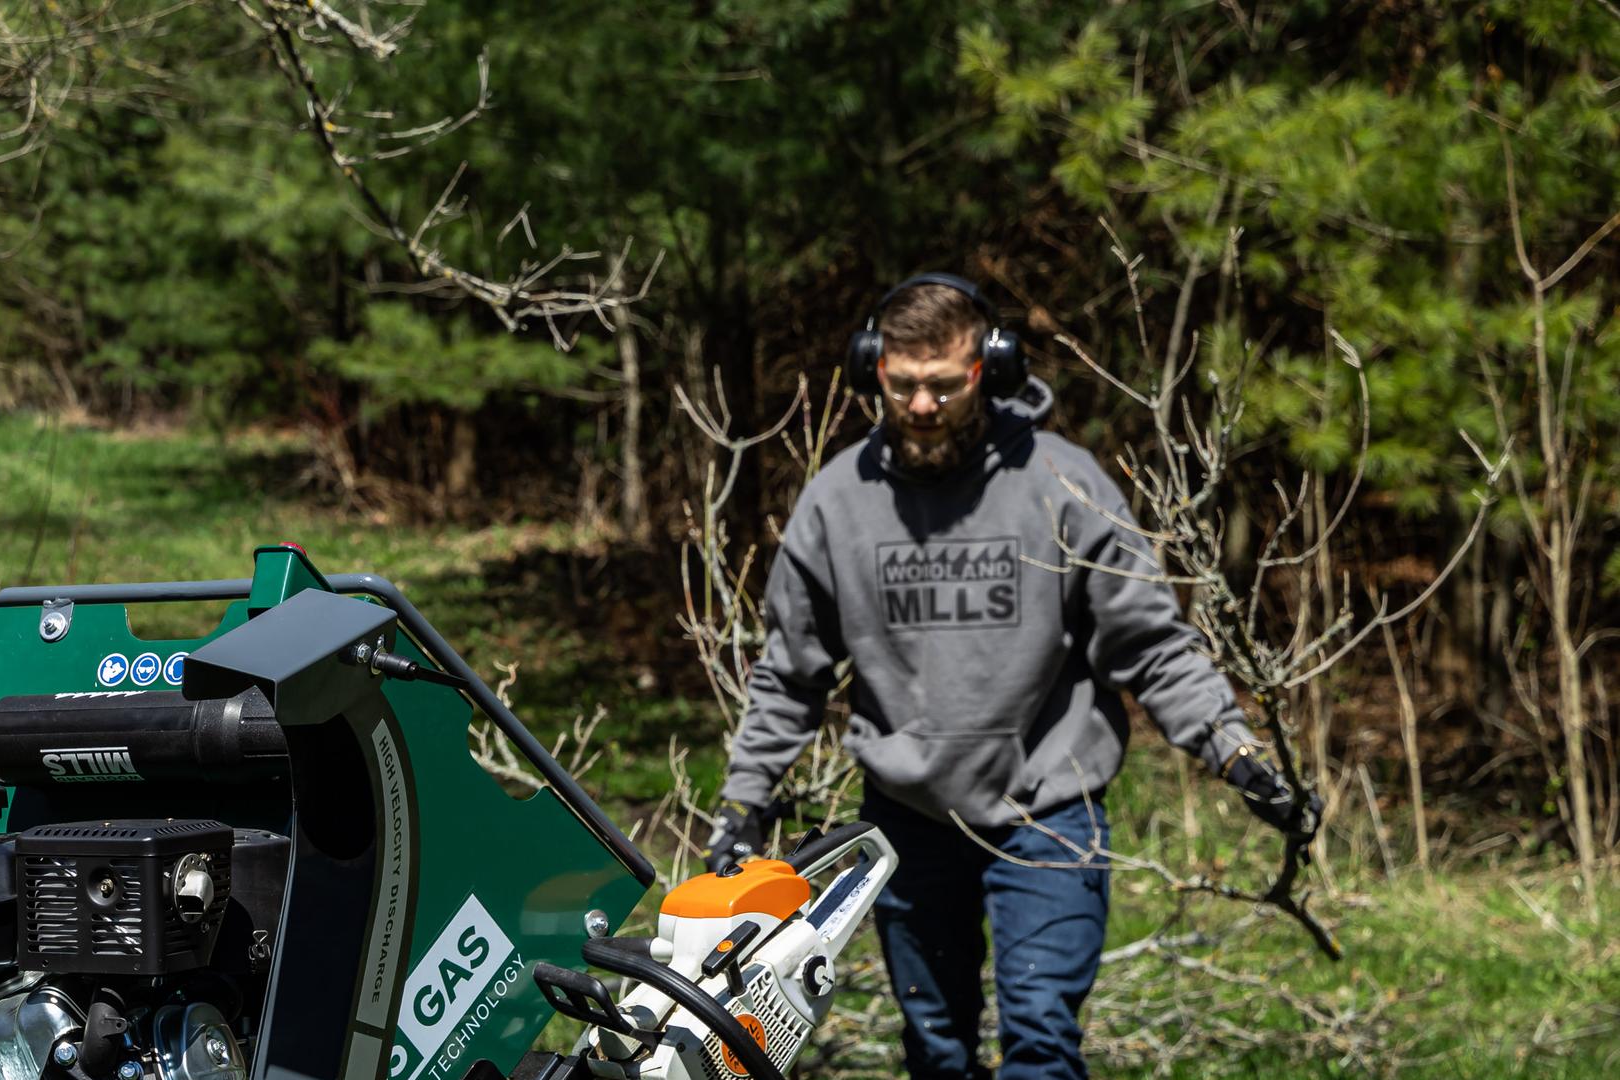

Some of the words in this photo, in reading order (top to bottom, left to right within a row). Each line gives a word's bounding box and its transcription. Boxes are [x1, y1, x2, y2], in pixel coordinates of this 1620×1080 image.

[885, 585, 1015, 624] MLLS
[42, 752, 136, 776] MILLS
[378, 735, 396, 780] HIGH
[390, 782, 402, 876] VELOCITY
[371, 884, 399, 1003] DISCHARGE
[413, 925, 490, 1027] GAS
[429, 953, 525, 1080] TECHNOLOGY
